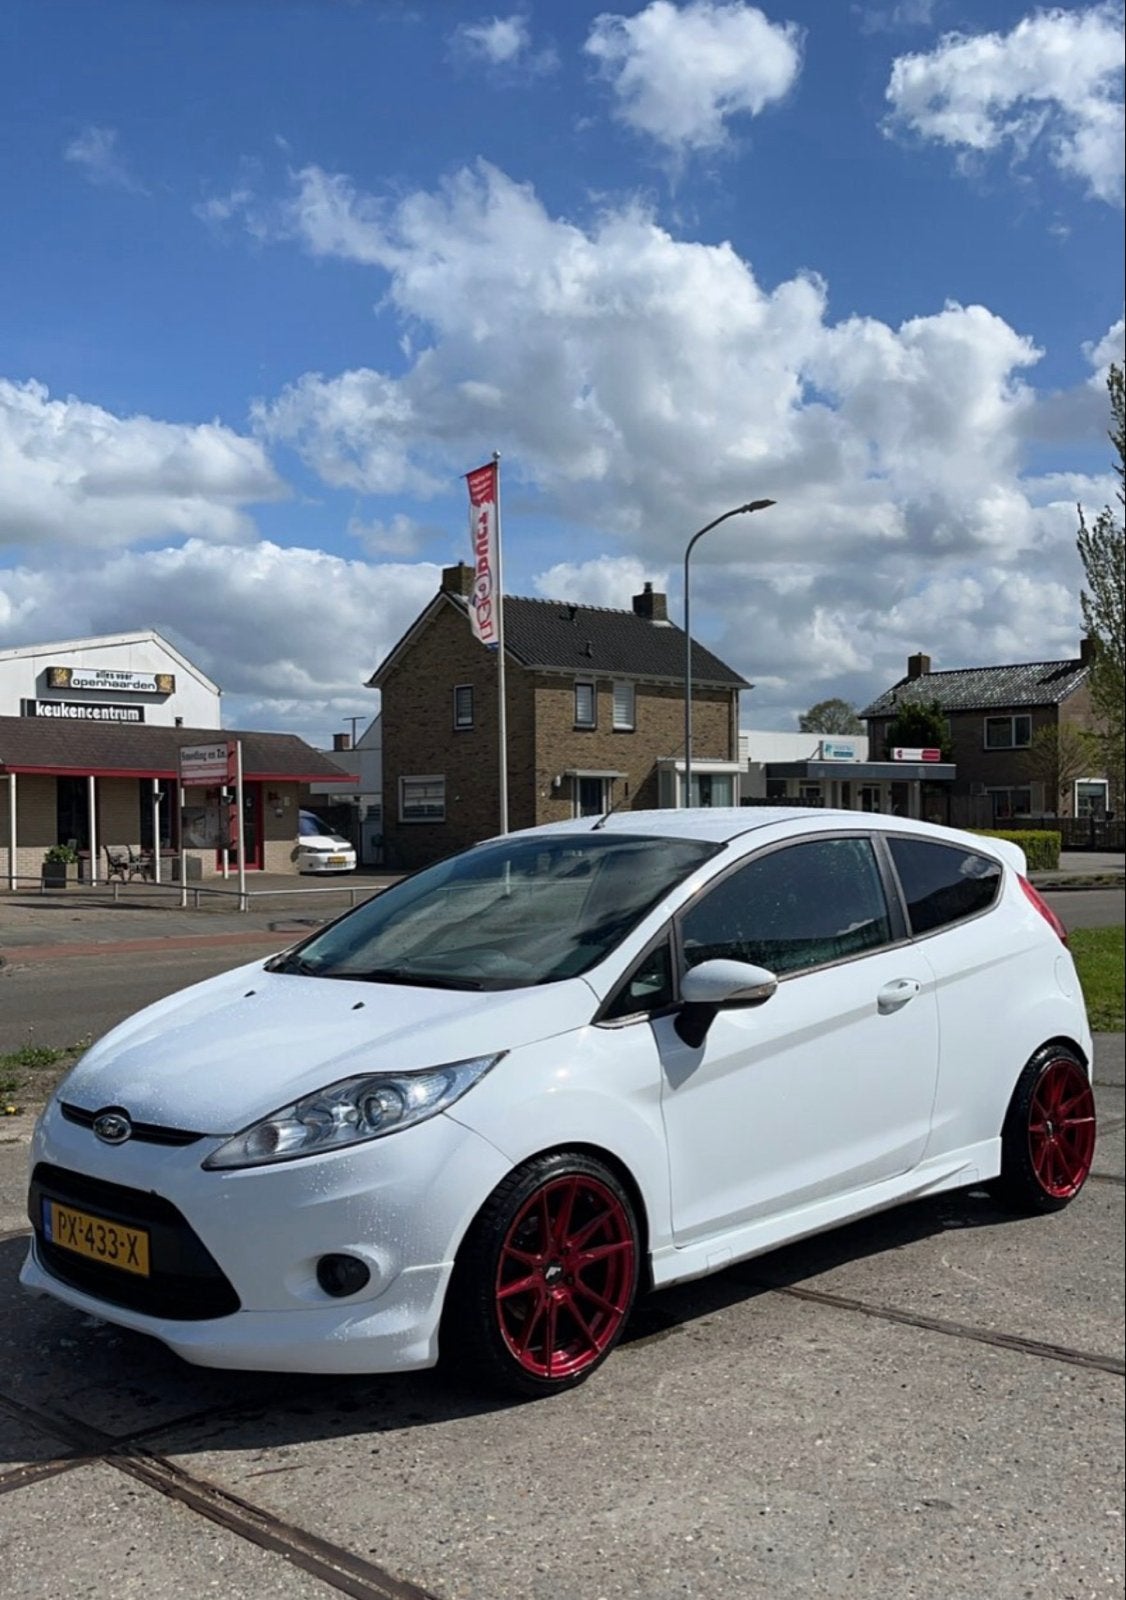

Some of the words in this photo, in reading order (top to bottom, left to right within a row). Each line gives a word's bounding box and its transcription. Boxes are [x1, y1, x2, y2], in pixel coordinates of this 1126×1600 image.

[72, 677, 156, 691] openhaarden
[35, 700, 140, 721] keukencentrum
[58, 1210, 139, 1267] PX-433-X
